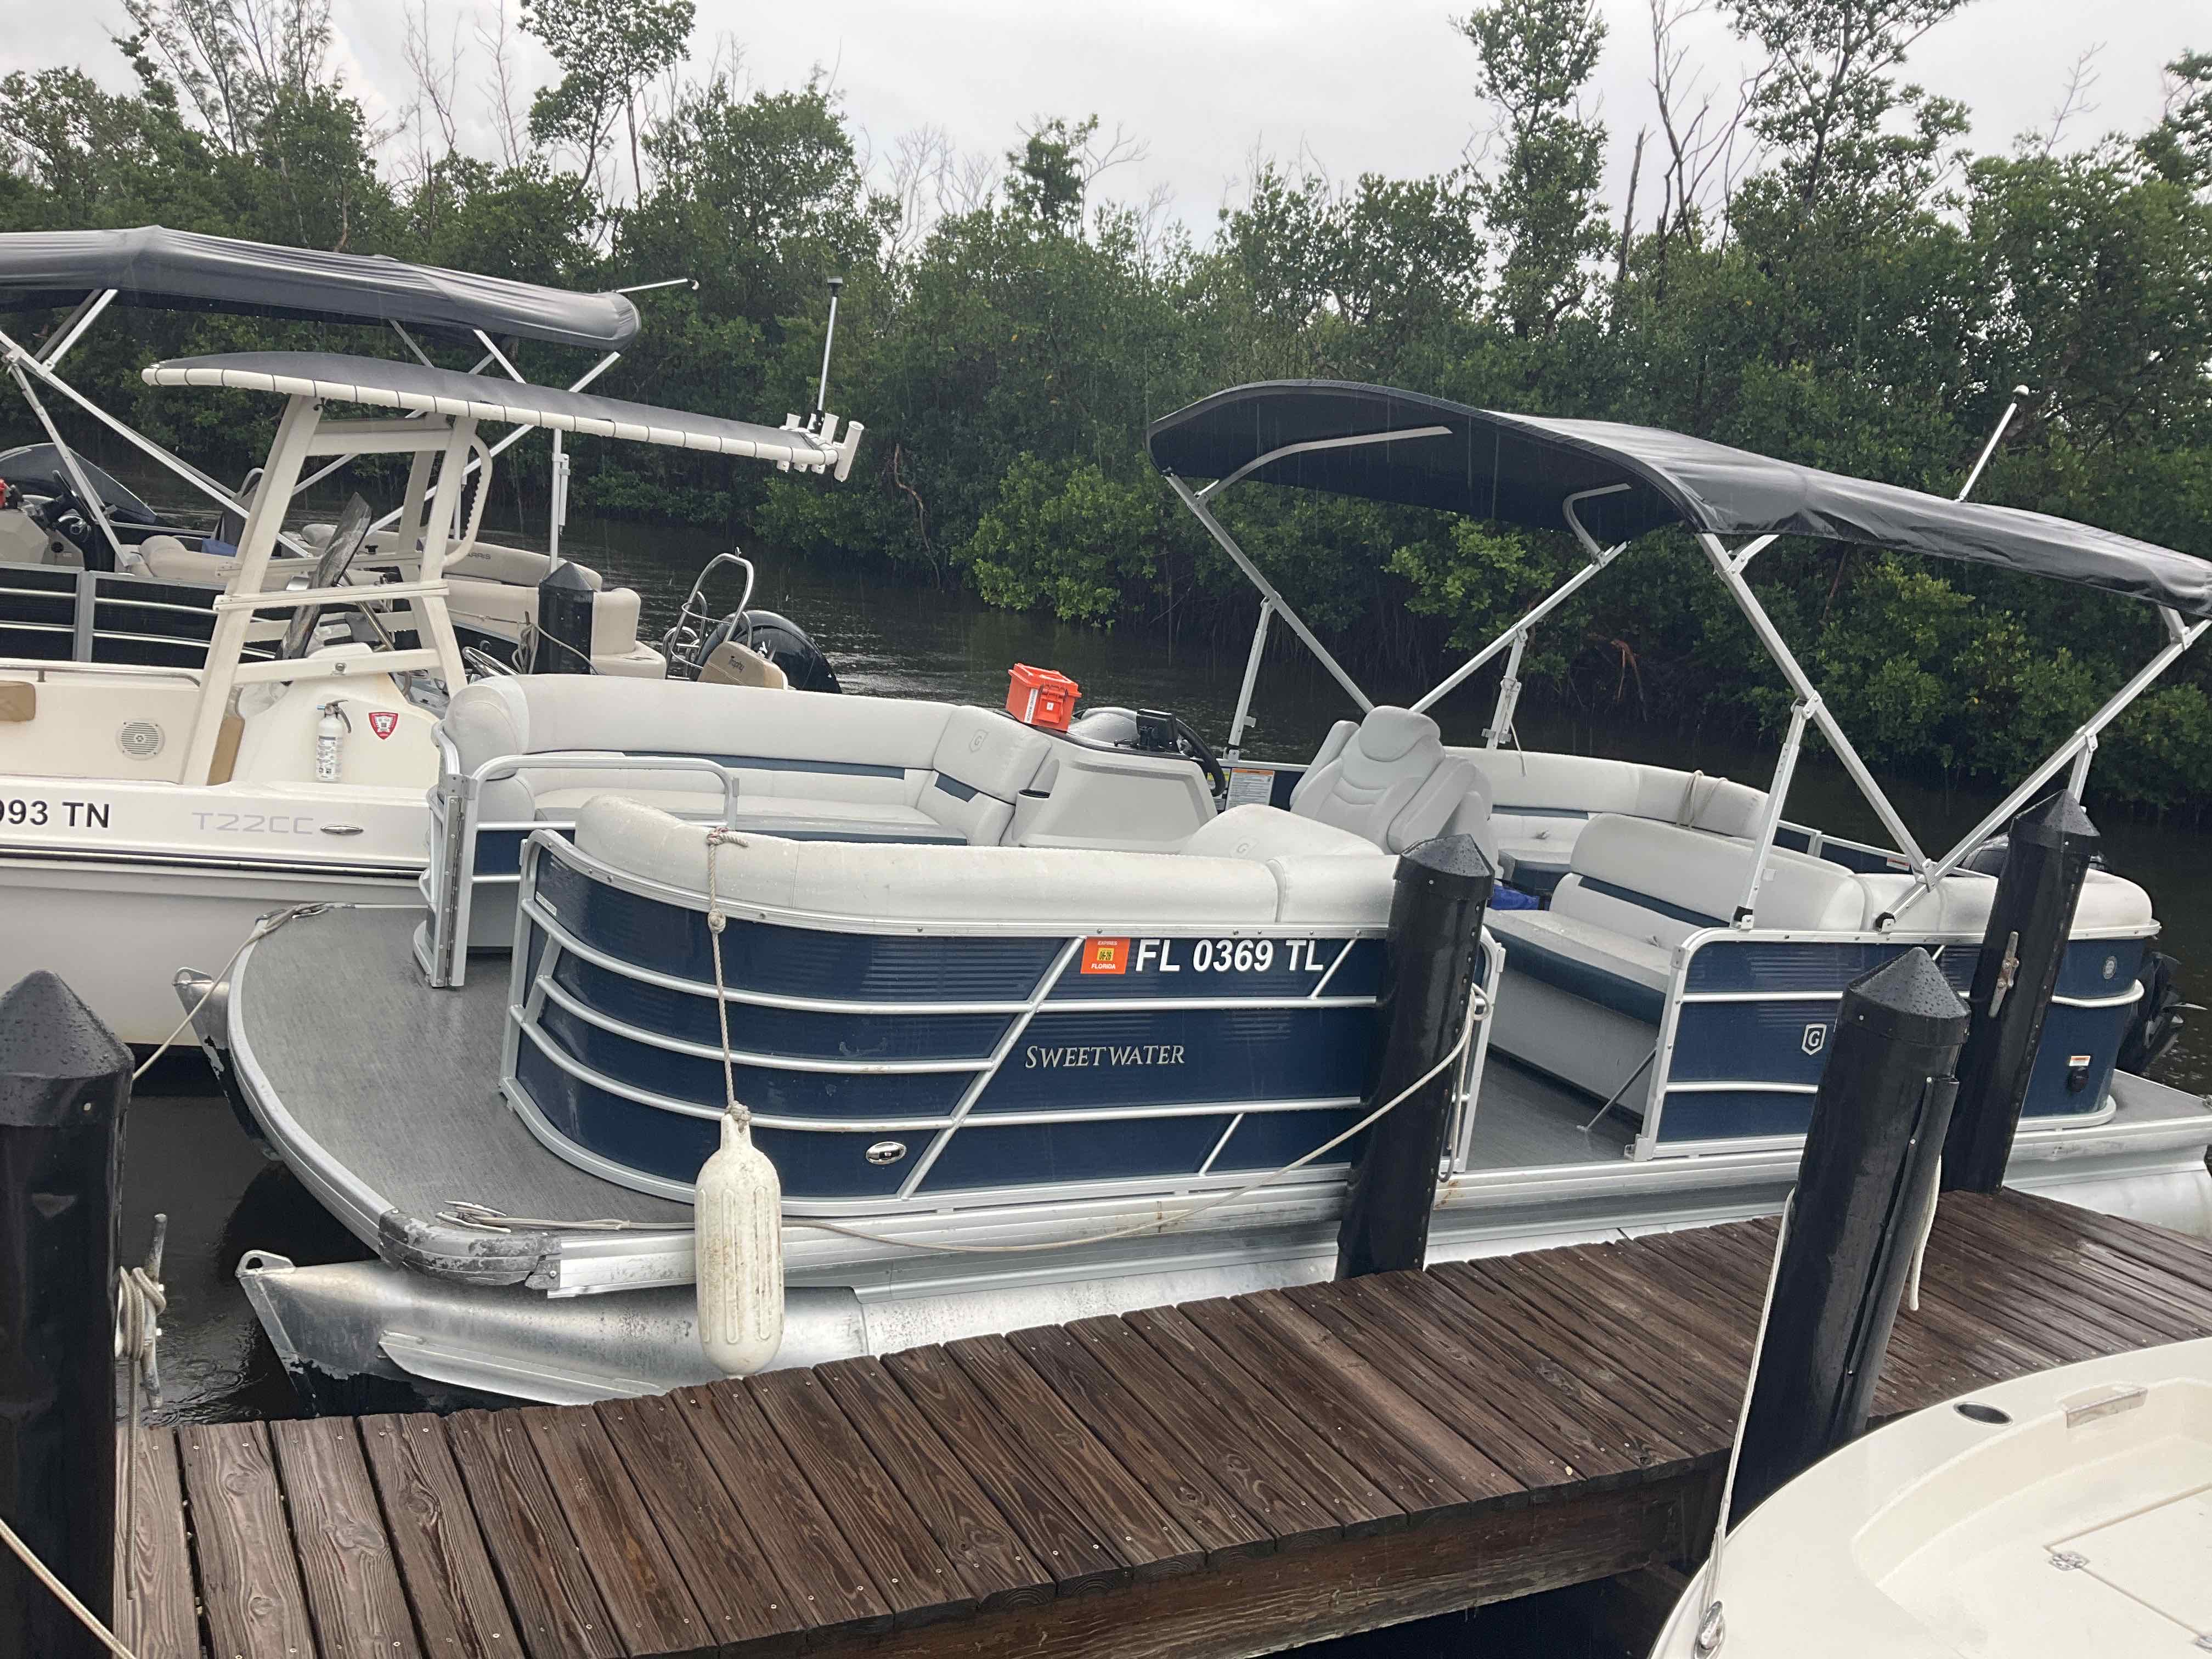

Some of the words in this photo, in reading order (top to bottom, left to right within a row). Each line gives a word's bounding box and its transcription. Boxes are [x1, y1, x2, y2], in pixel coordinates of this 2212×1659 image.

[0, 799, 48, 825] 93
[62, 802, 109, 828] TN
[191, 812, 314, 834] T22CC
[1136, 939, 1180, 972] FL
[1193, 939, 1274, 972] 0369
[1285, 940, 1324, 971] TL
